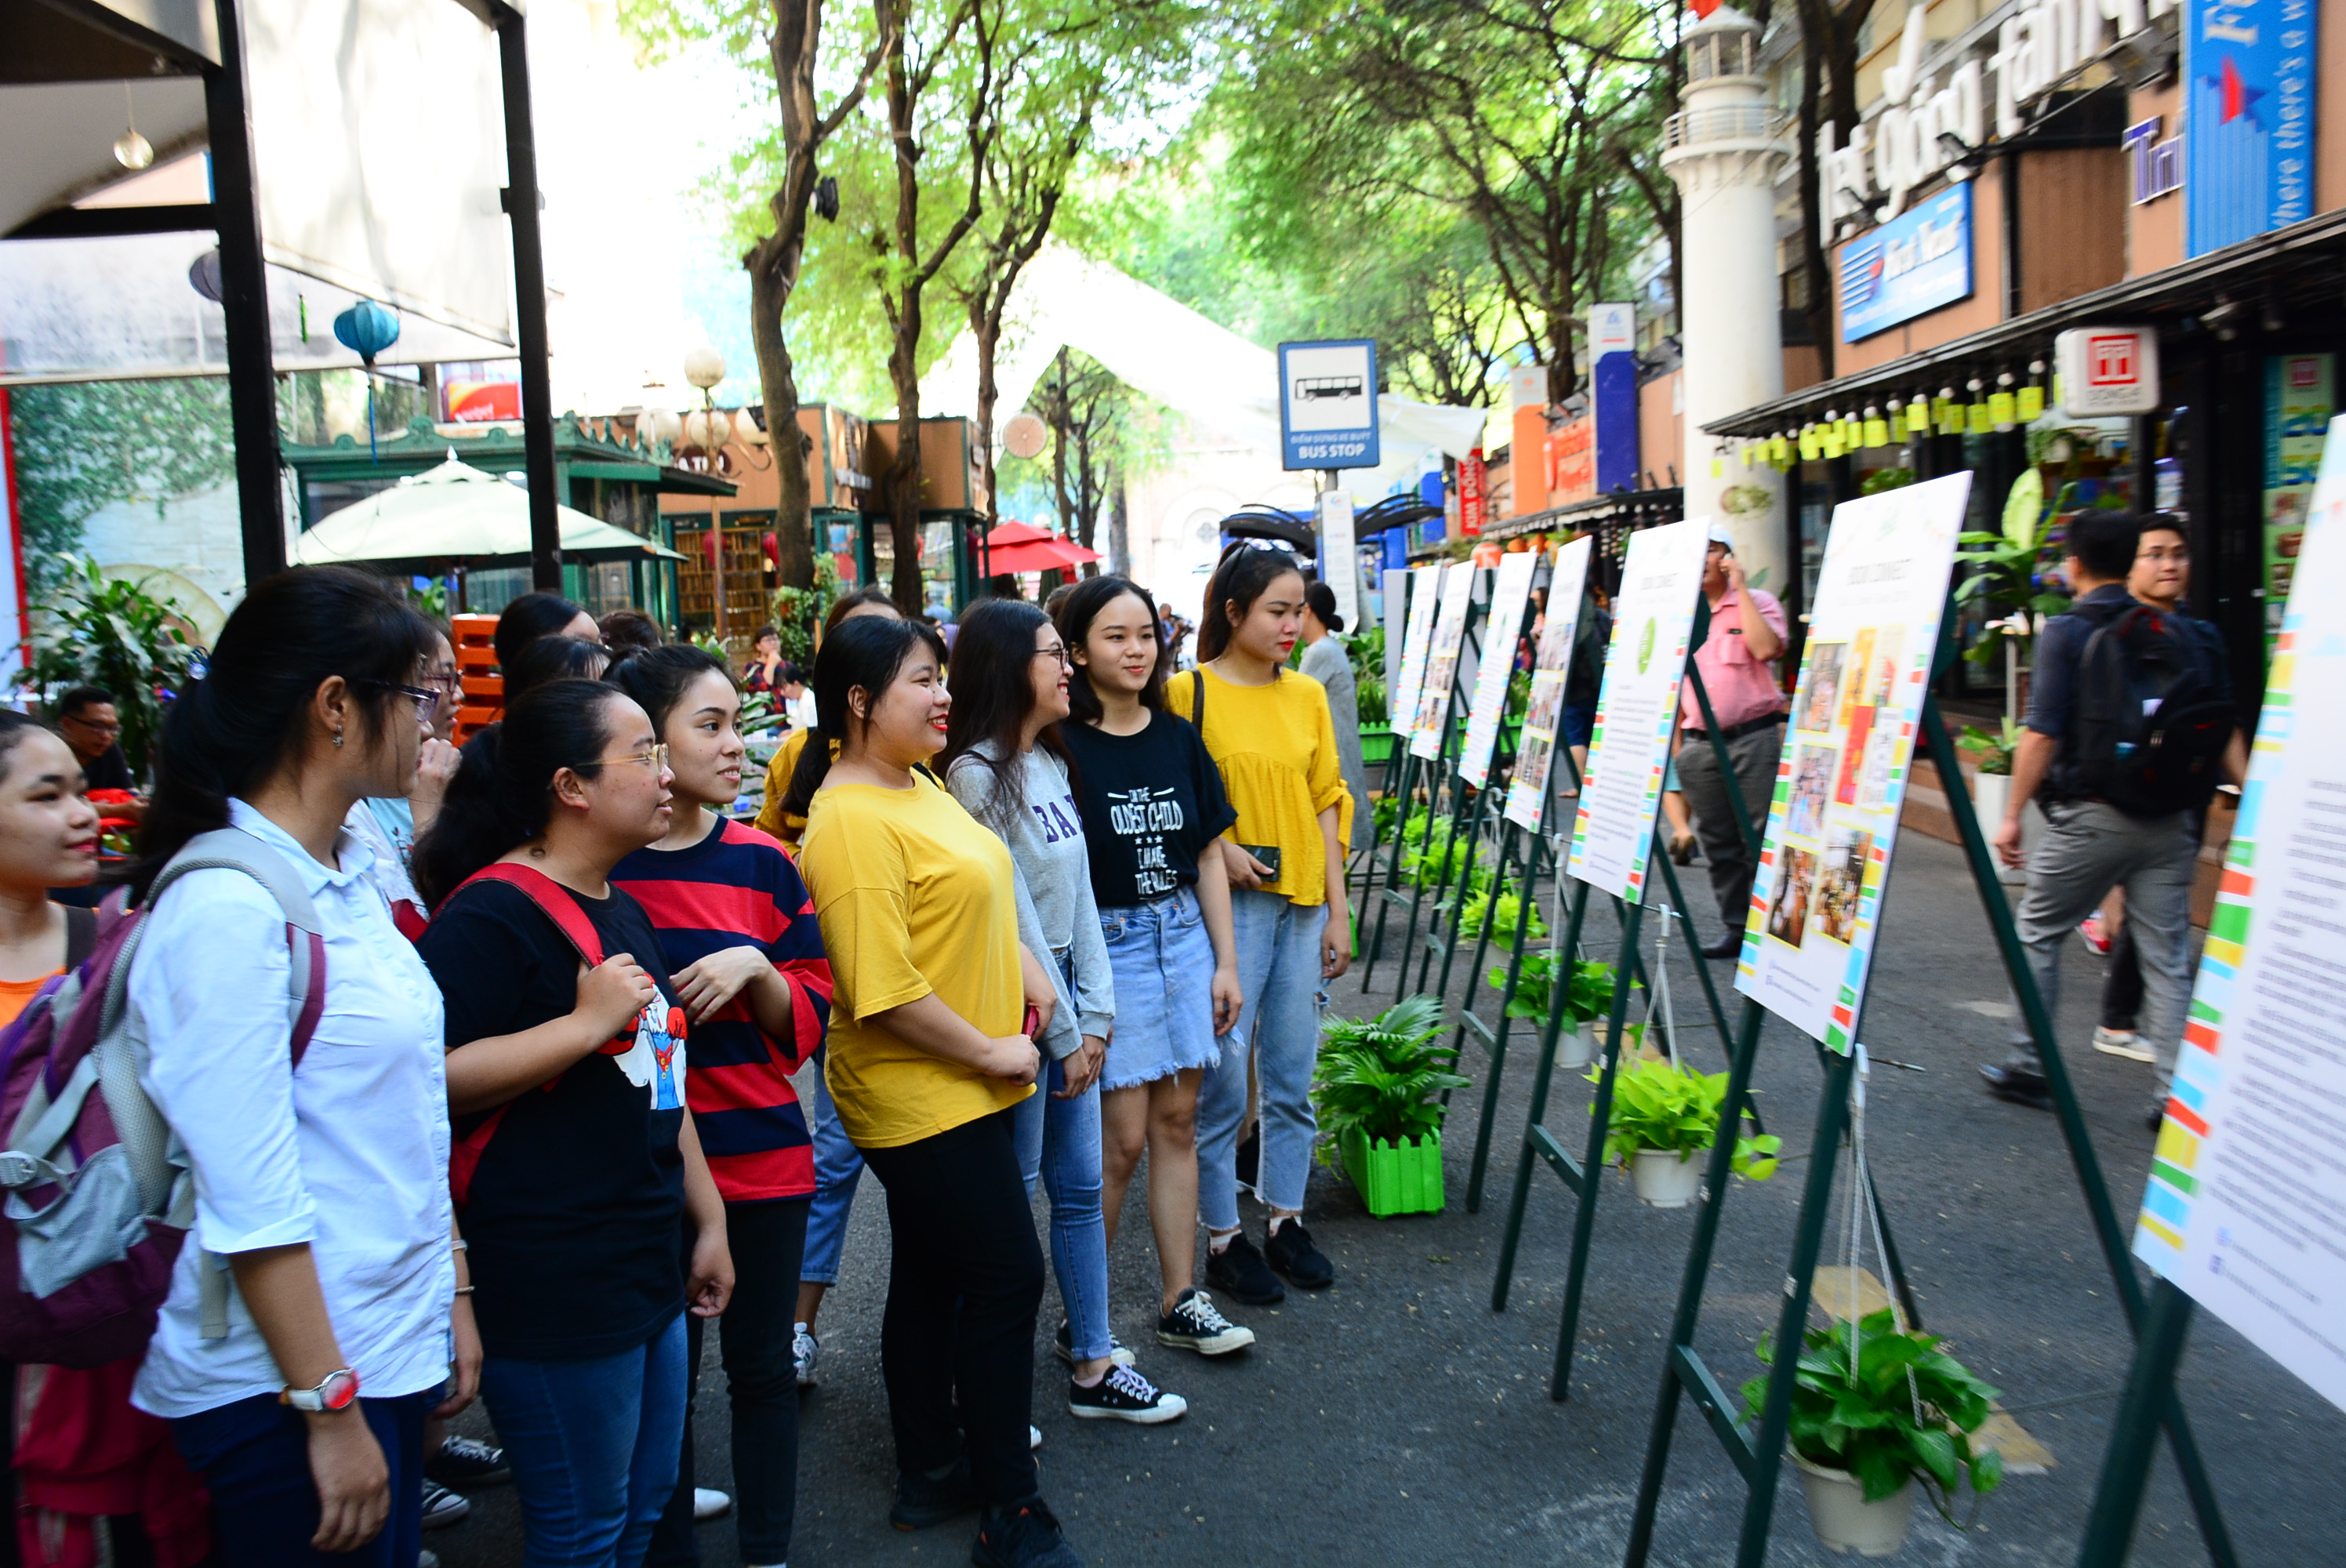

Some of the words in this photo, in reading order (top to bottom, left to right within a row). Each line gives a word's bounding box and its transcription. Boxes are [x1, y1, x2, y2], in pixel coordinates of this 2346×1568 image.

[1298, 445, 1328, 459] BUS
[1328, 442, 1366, 458] STOP
[1464, 502, 1479, 529] KIM
[1110, 803, 1147, 835] OLDEST
[1147, 800, 1184, 832] CHILD
[1135, 871, 1153, 895] THE
[1150, 869, 1178, 892] RULES
